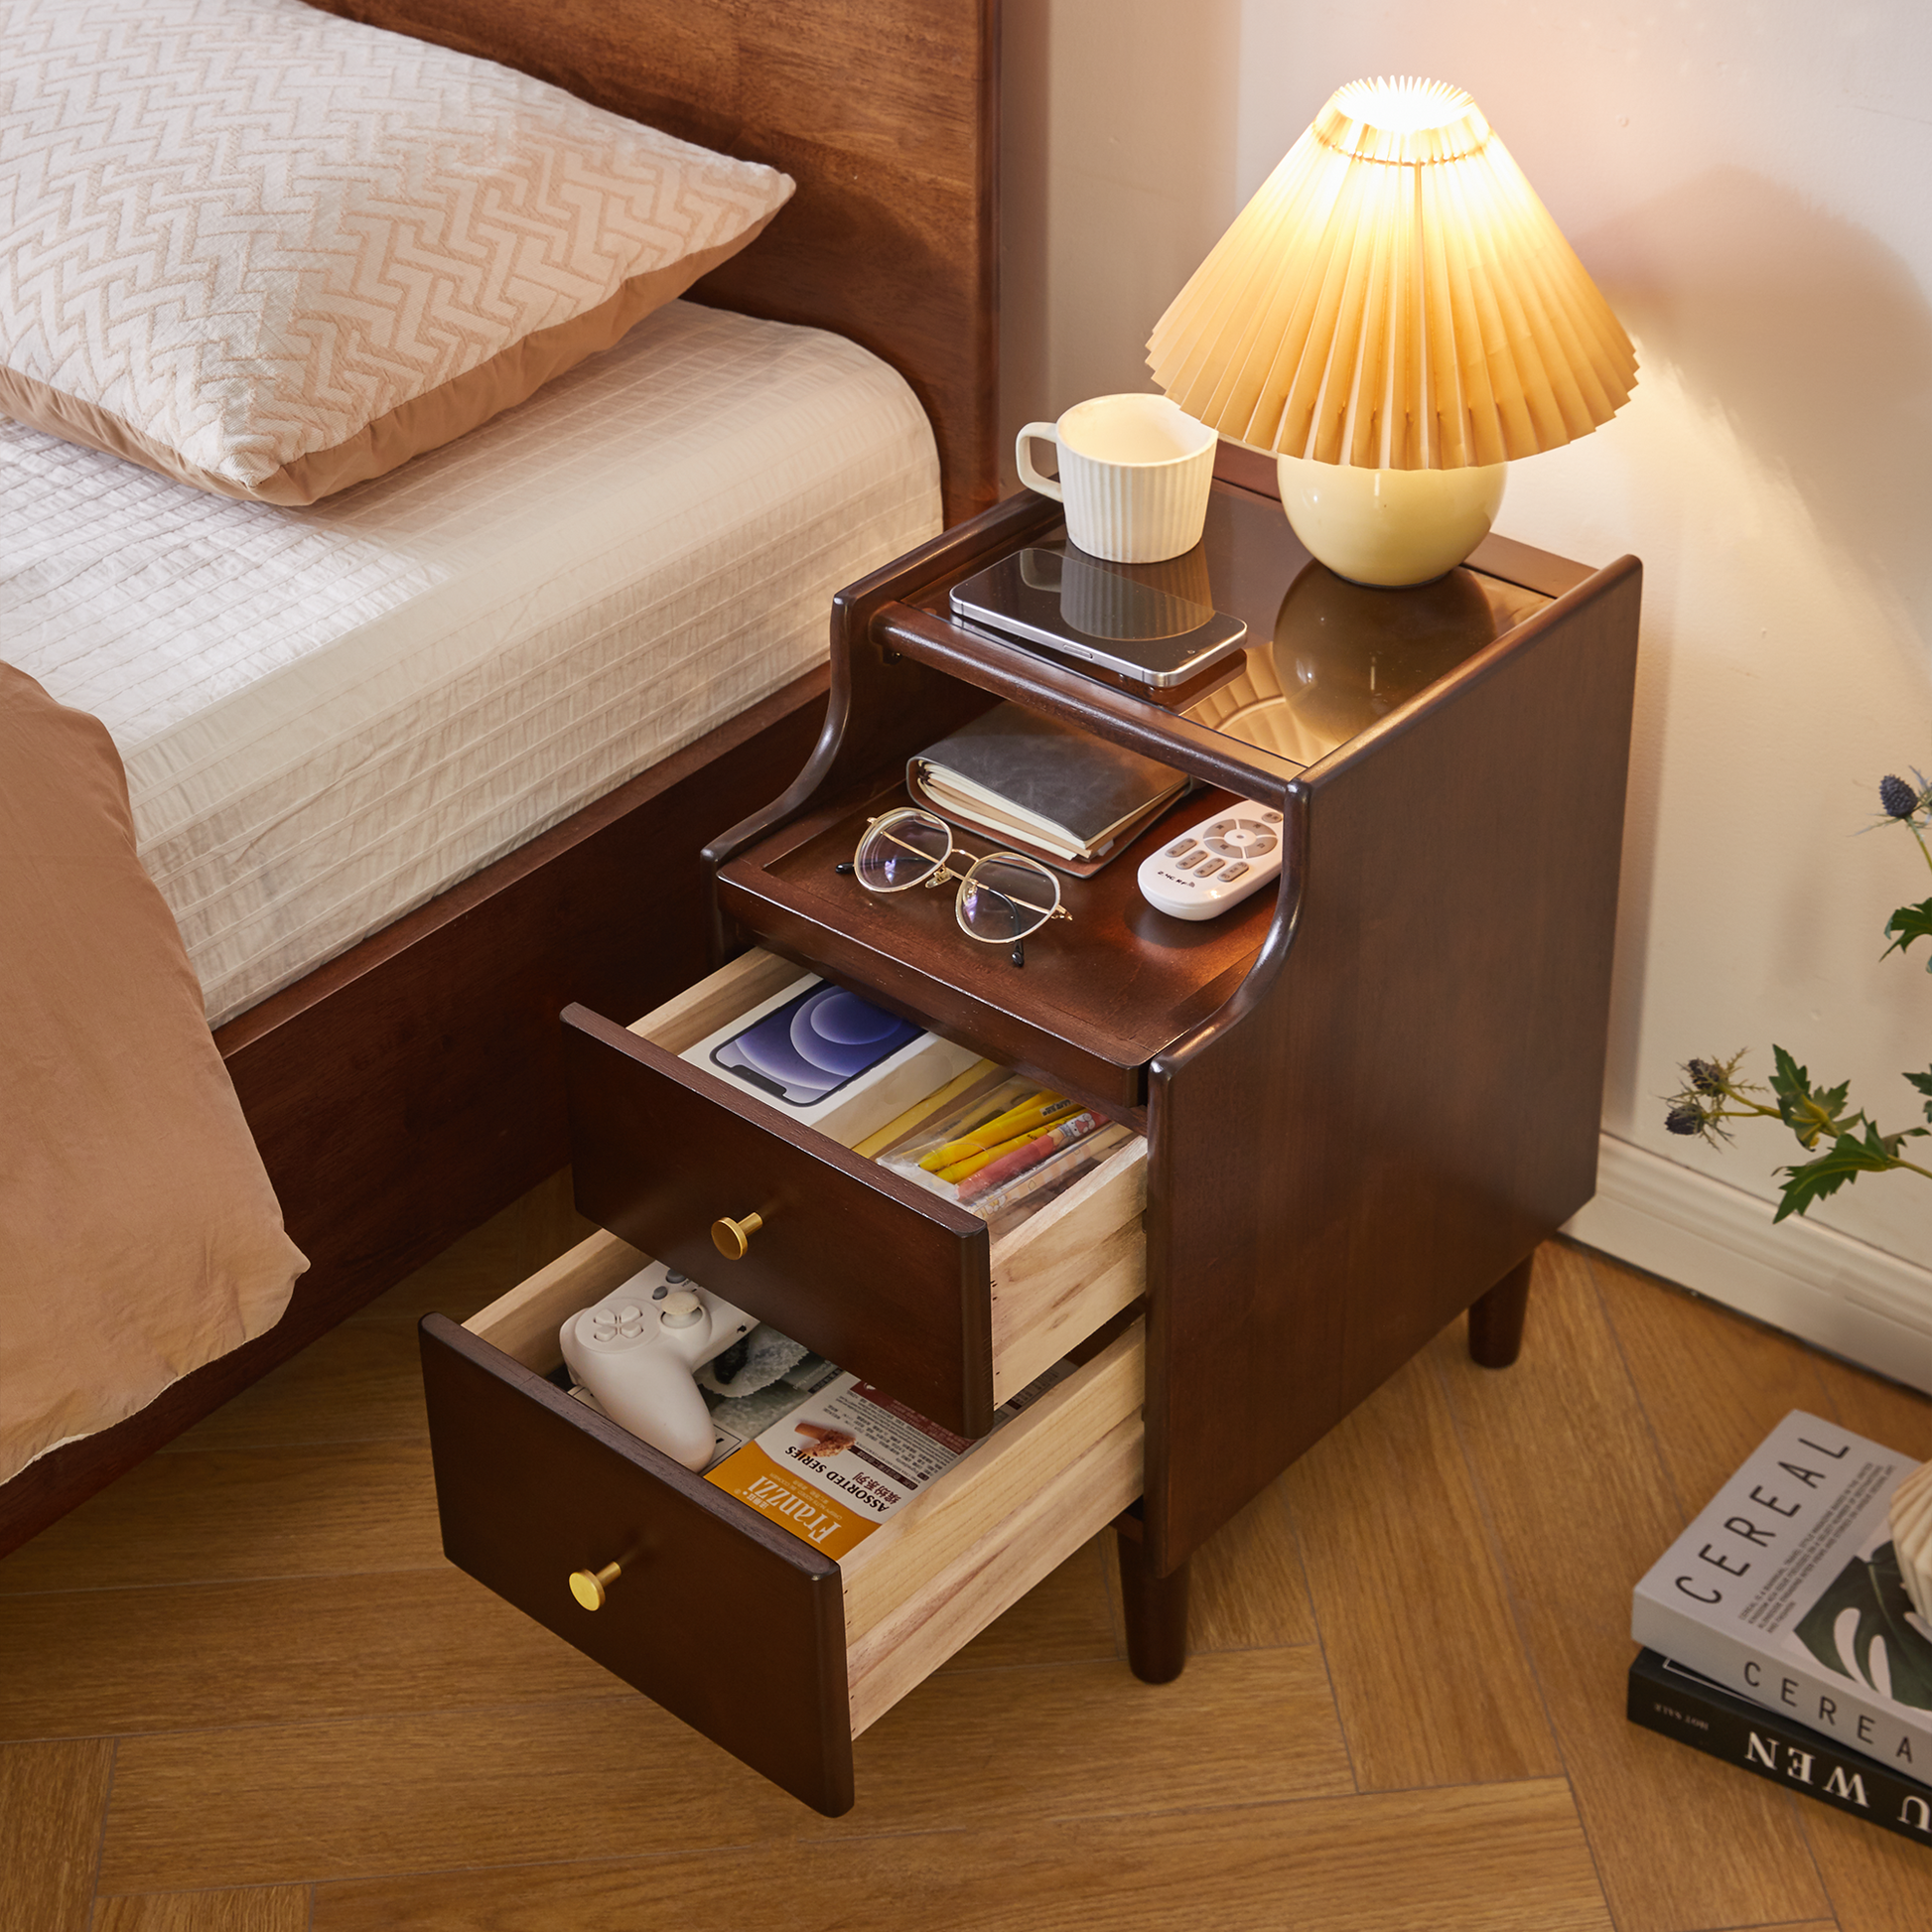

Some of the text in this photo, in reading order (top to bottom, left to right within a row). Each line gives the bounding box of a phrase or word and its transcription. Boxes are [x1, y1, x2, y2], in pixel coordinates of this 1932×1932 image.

[784, 1445, 828, 1474] SERIES
[826, 1470, 891, 1513] ASSORTED
[743, 1475, 842, 1544] Franzzi
[1675, 1438, 1852, 1604] CEREAL
[1744, 1730, 1870, 1808] WEN
